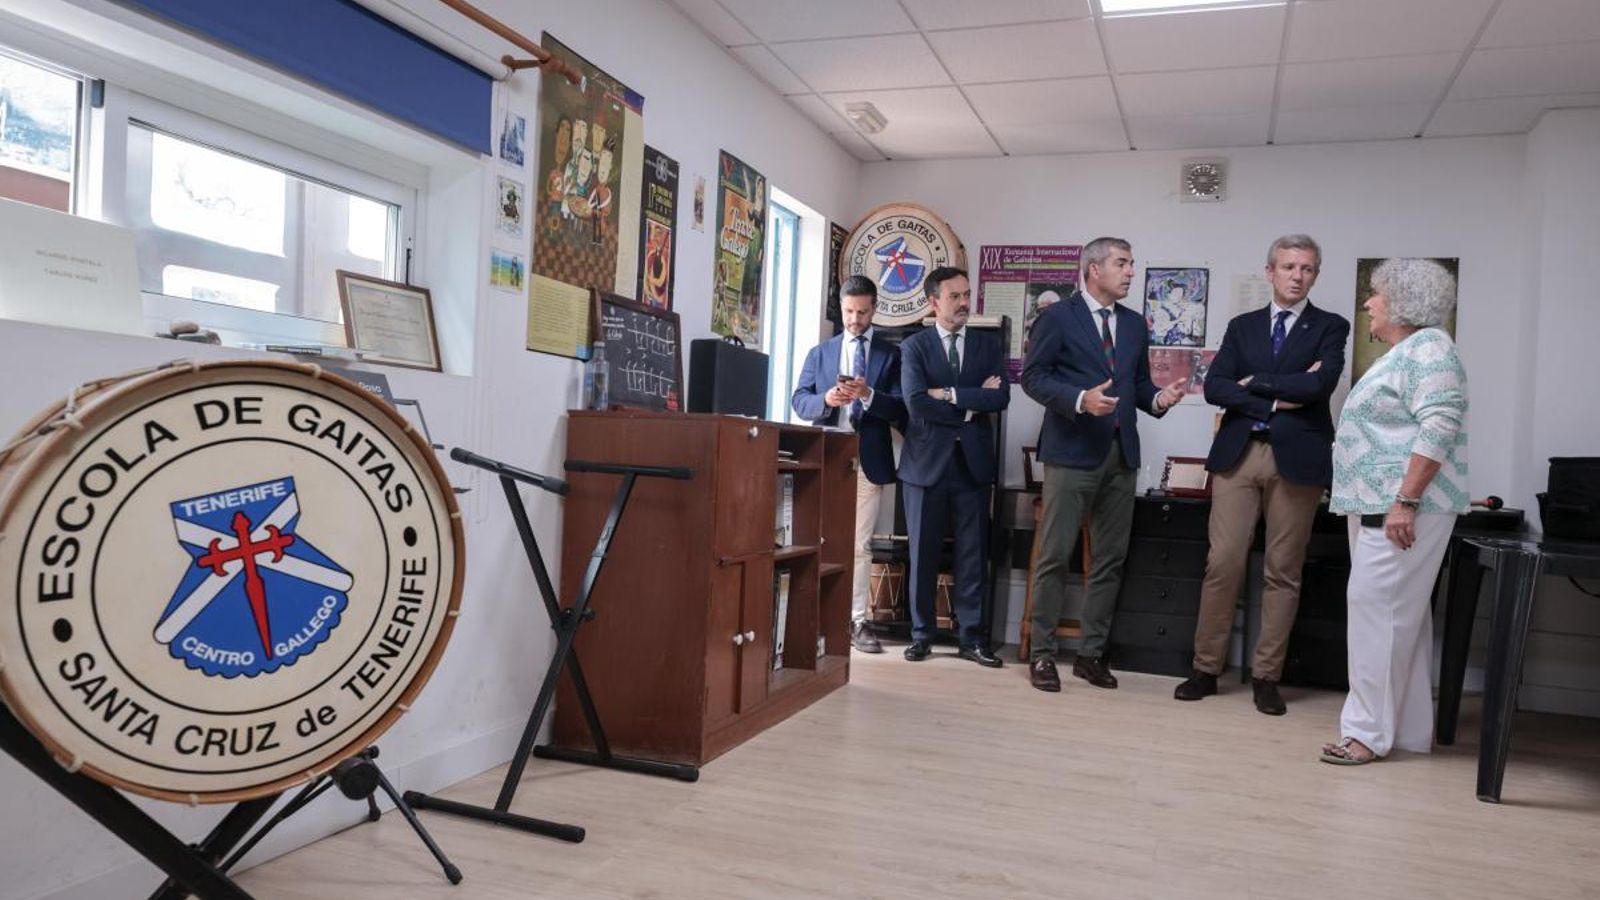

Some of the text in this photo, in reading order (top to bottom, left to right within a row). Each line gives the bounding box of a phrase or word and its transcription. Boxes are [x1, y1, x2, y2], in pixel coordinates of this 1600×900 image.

[853, 234, 876, 275] SCOLA
[877, 221, 893, 234] DE
[897, 219, 936, 244] GAITAS
[981, 247, 1001, 269] XIX
[891, 302, 916, 314] CRUZ
[38, 397, 413, 602] ESCOLA DE GAITAS
[181, 481, 287, 516] TENERIFE
[59, 556, 427, 757] SANTA CRUZ de TENERIFE
[182, 595, 337, 666] CENTRO GALLEGO
